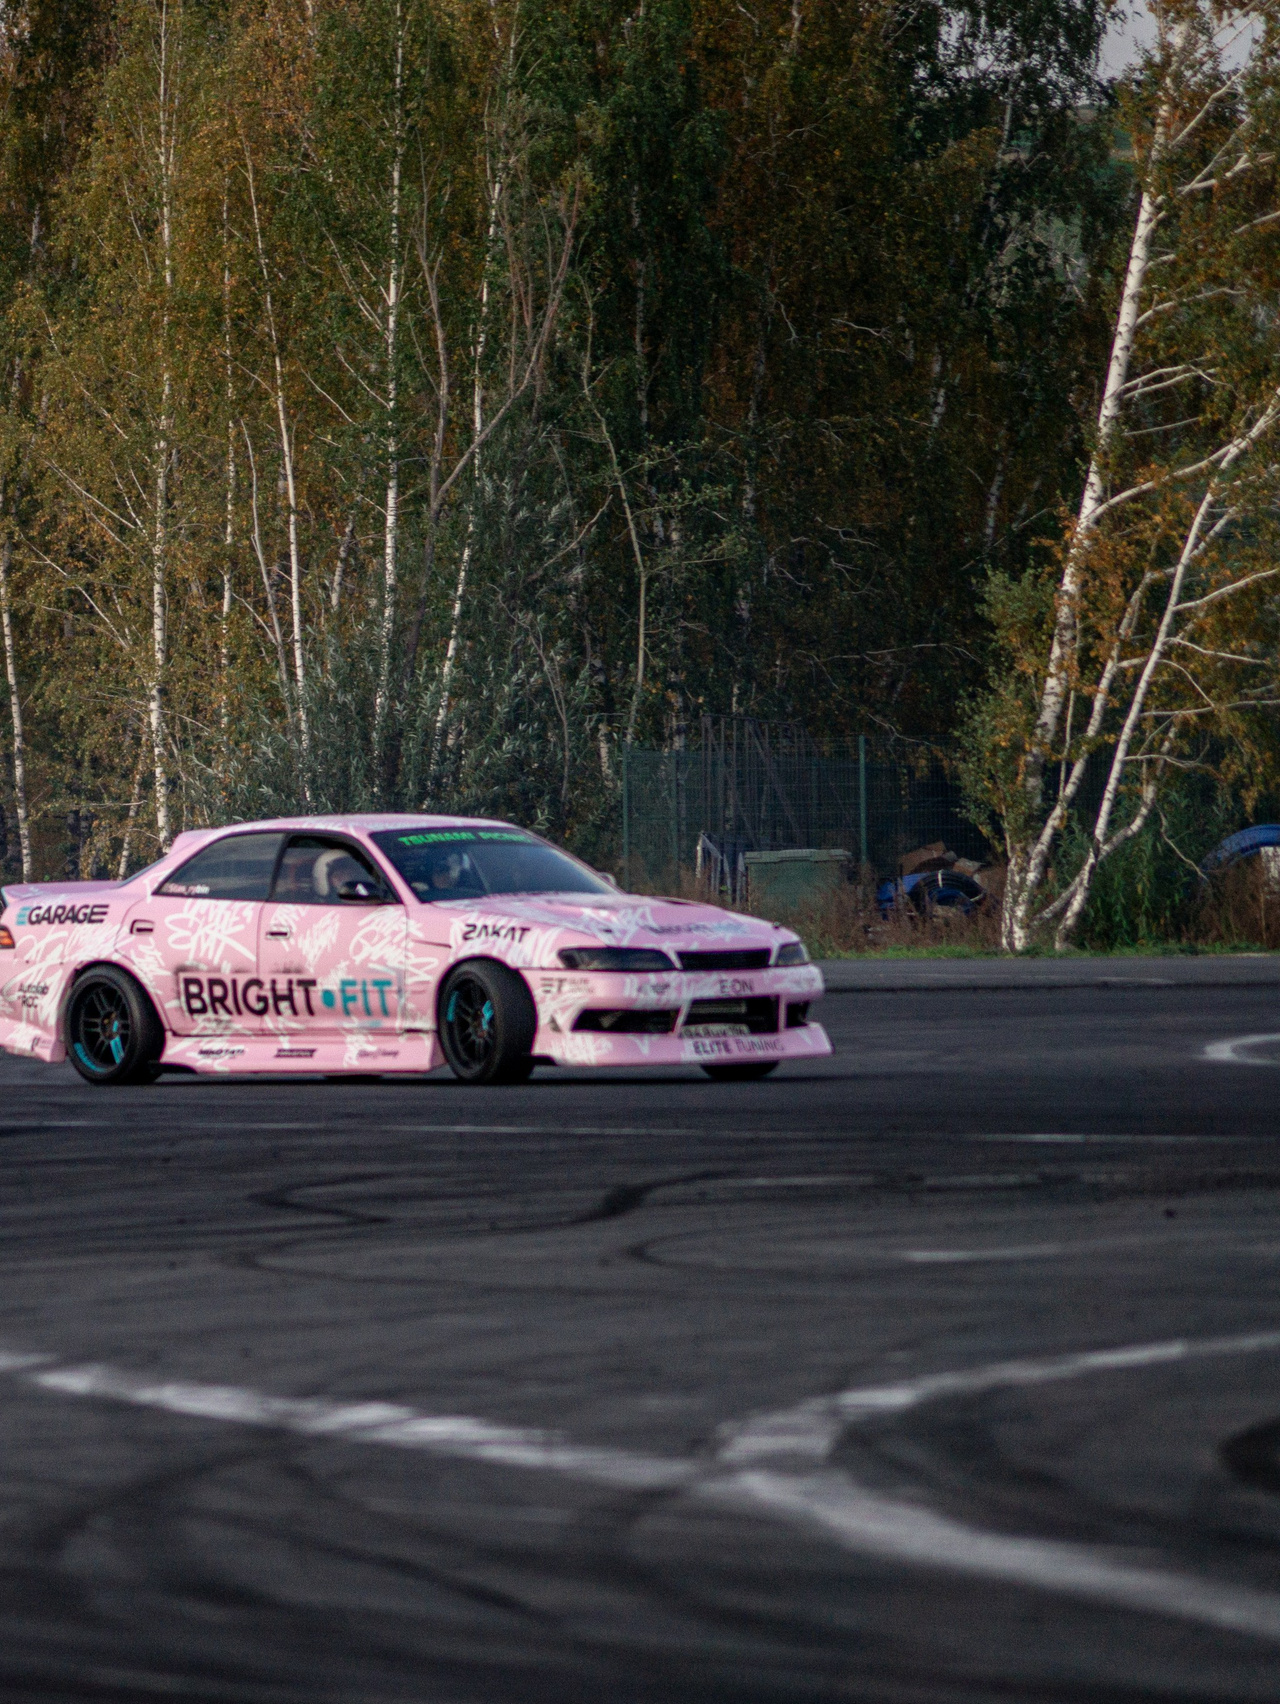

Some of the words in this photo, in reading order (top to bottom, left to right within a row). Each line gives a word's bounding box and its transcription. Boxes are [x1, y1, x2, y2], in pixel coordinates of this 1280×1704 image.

[462, 923, 531, 943] ZAKAT
[183, 977, 317, 1017] BRIGHT
[340, 979, 393, 1017] FIT
[692, 1040, 732, 1055] ELITE
